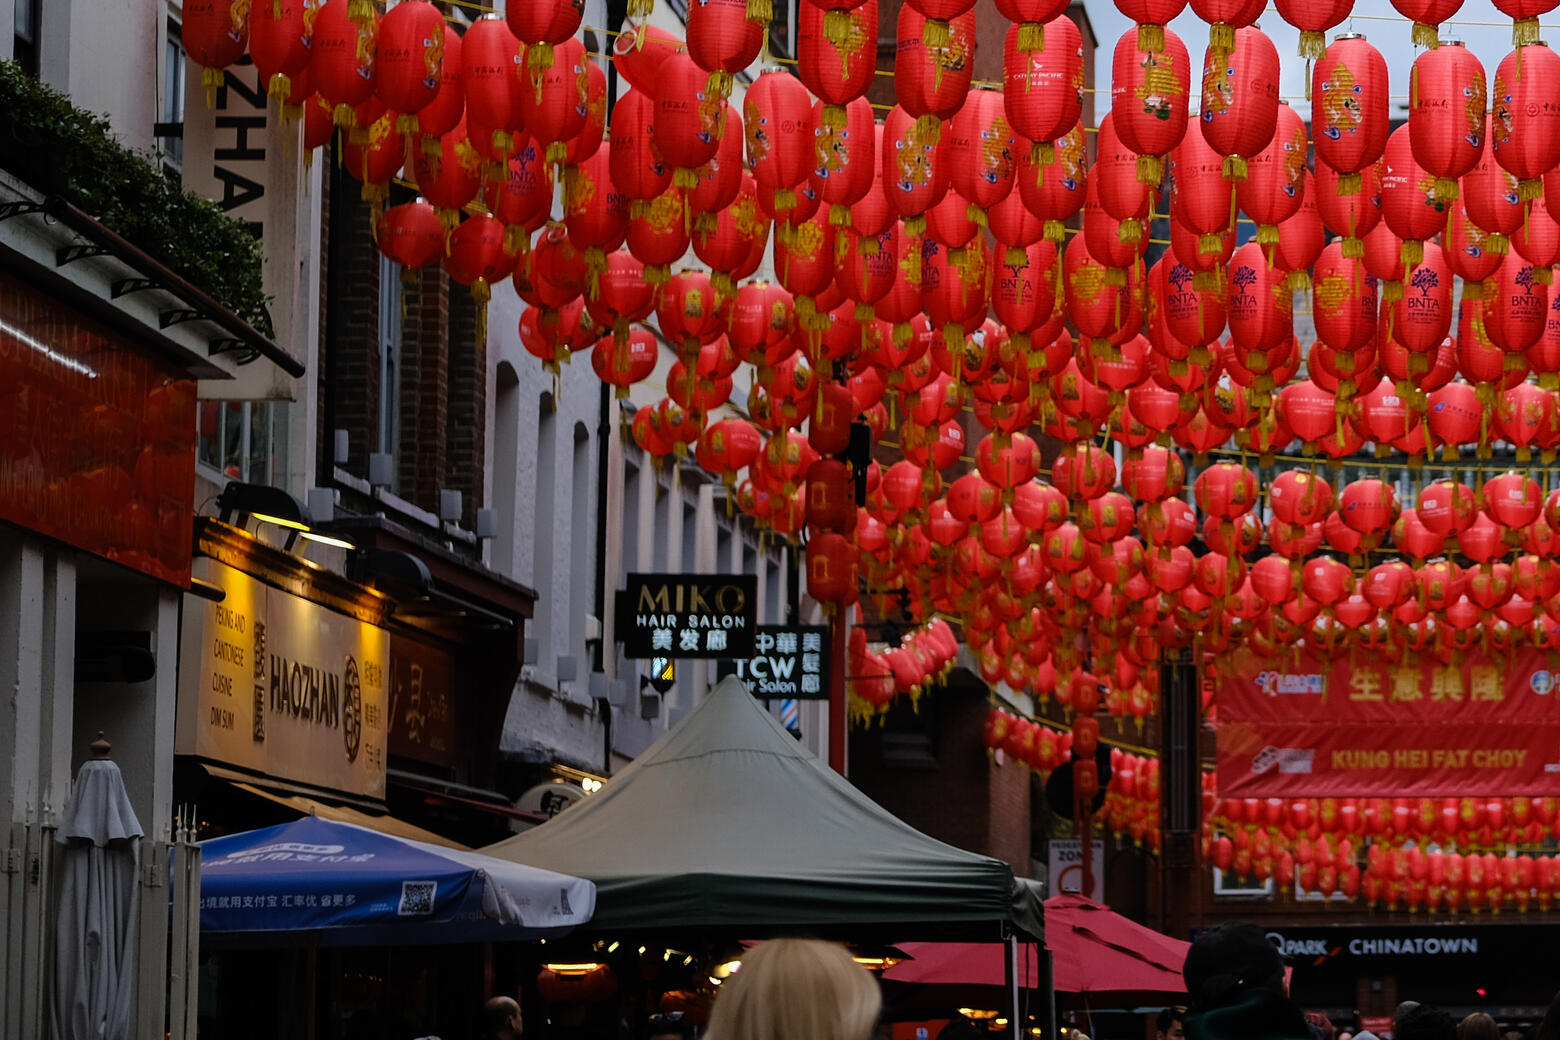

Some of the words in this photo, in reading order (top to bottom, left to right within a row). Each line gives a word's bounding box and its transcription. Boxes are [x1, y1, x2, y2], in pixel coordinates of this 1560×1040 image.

[1168, 292, 1198, 305] BNTA
[1230, 295, 1257, 306] BNTA
[1407, 296, 1440, 309] BNTA
[1511, 295, 1542, 307] BNTA
[638, 583, 745, 613] MIKO
[215, 606, 234, 631] PEKING
[234, 614, 246, 634] AND
[636, 614, 677, 628] HAIR
[688, 614, 745, 629] SALON
[652, 628, 728, 651] 美发廊
[755, 632, 798, 655] 中華
[213, 638, 244, 668] CANTONESE
[734, 655, 796, 679] TCW
[212, 672, 233, 697] CUISINE
[270, 654, 340, 730] HAOZHAN
[758, 678, 797, 694] Salon
[1332, 750, 1389, 769] KUNG
[1393, 750, 1428, 769] HEI
[1432, 750, 1468, 769] FAT
[1471, 750, 1528, 769] CHOY
[1350, 937, 1478, 956] CHINATOWN
